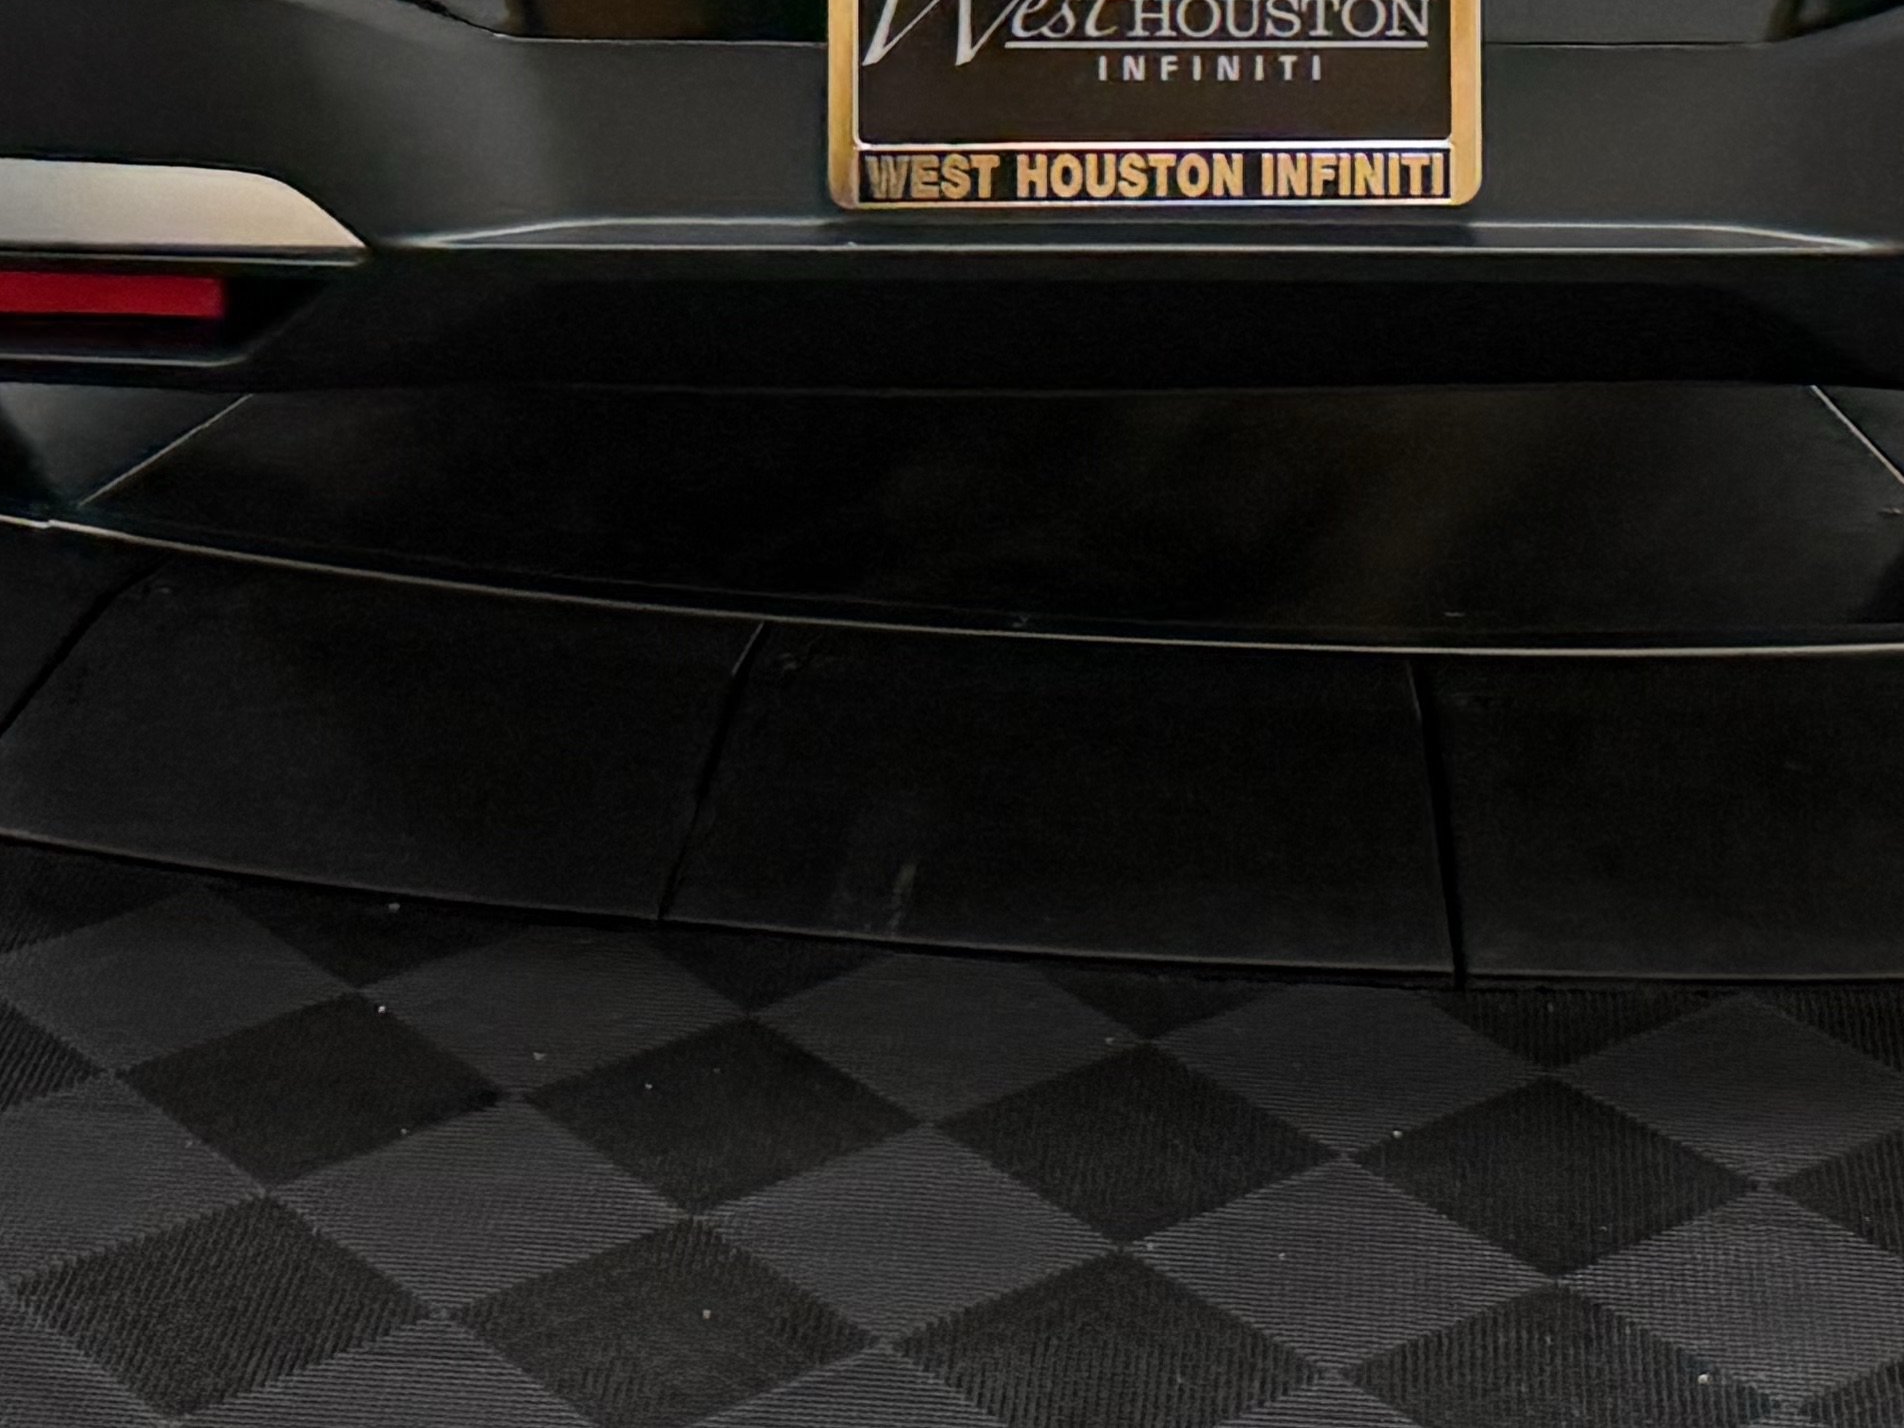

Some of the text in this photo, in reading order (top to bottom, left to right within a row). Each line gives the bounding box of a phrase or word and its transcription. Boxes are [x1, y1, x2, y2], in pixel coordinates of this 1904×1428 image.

[1098, 55, 1323, 82] INFINITI
[864, 152, 1447, 200] WEST HOUSTON INFINITI
